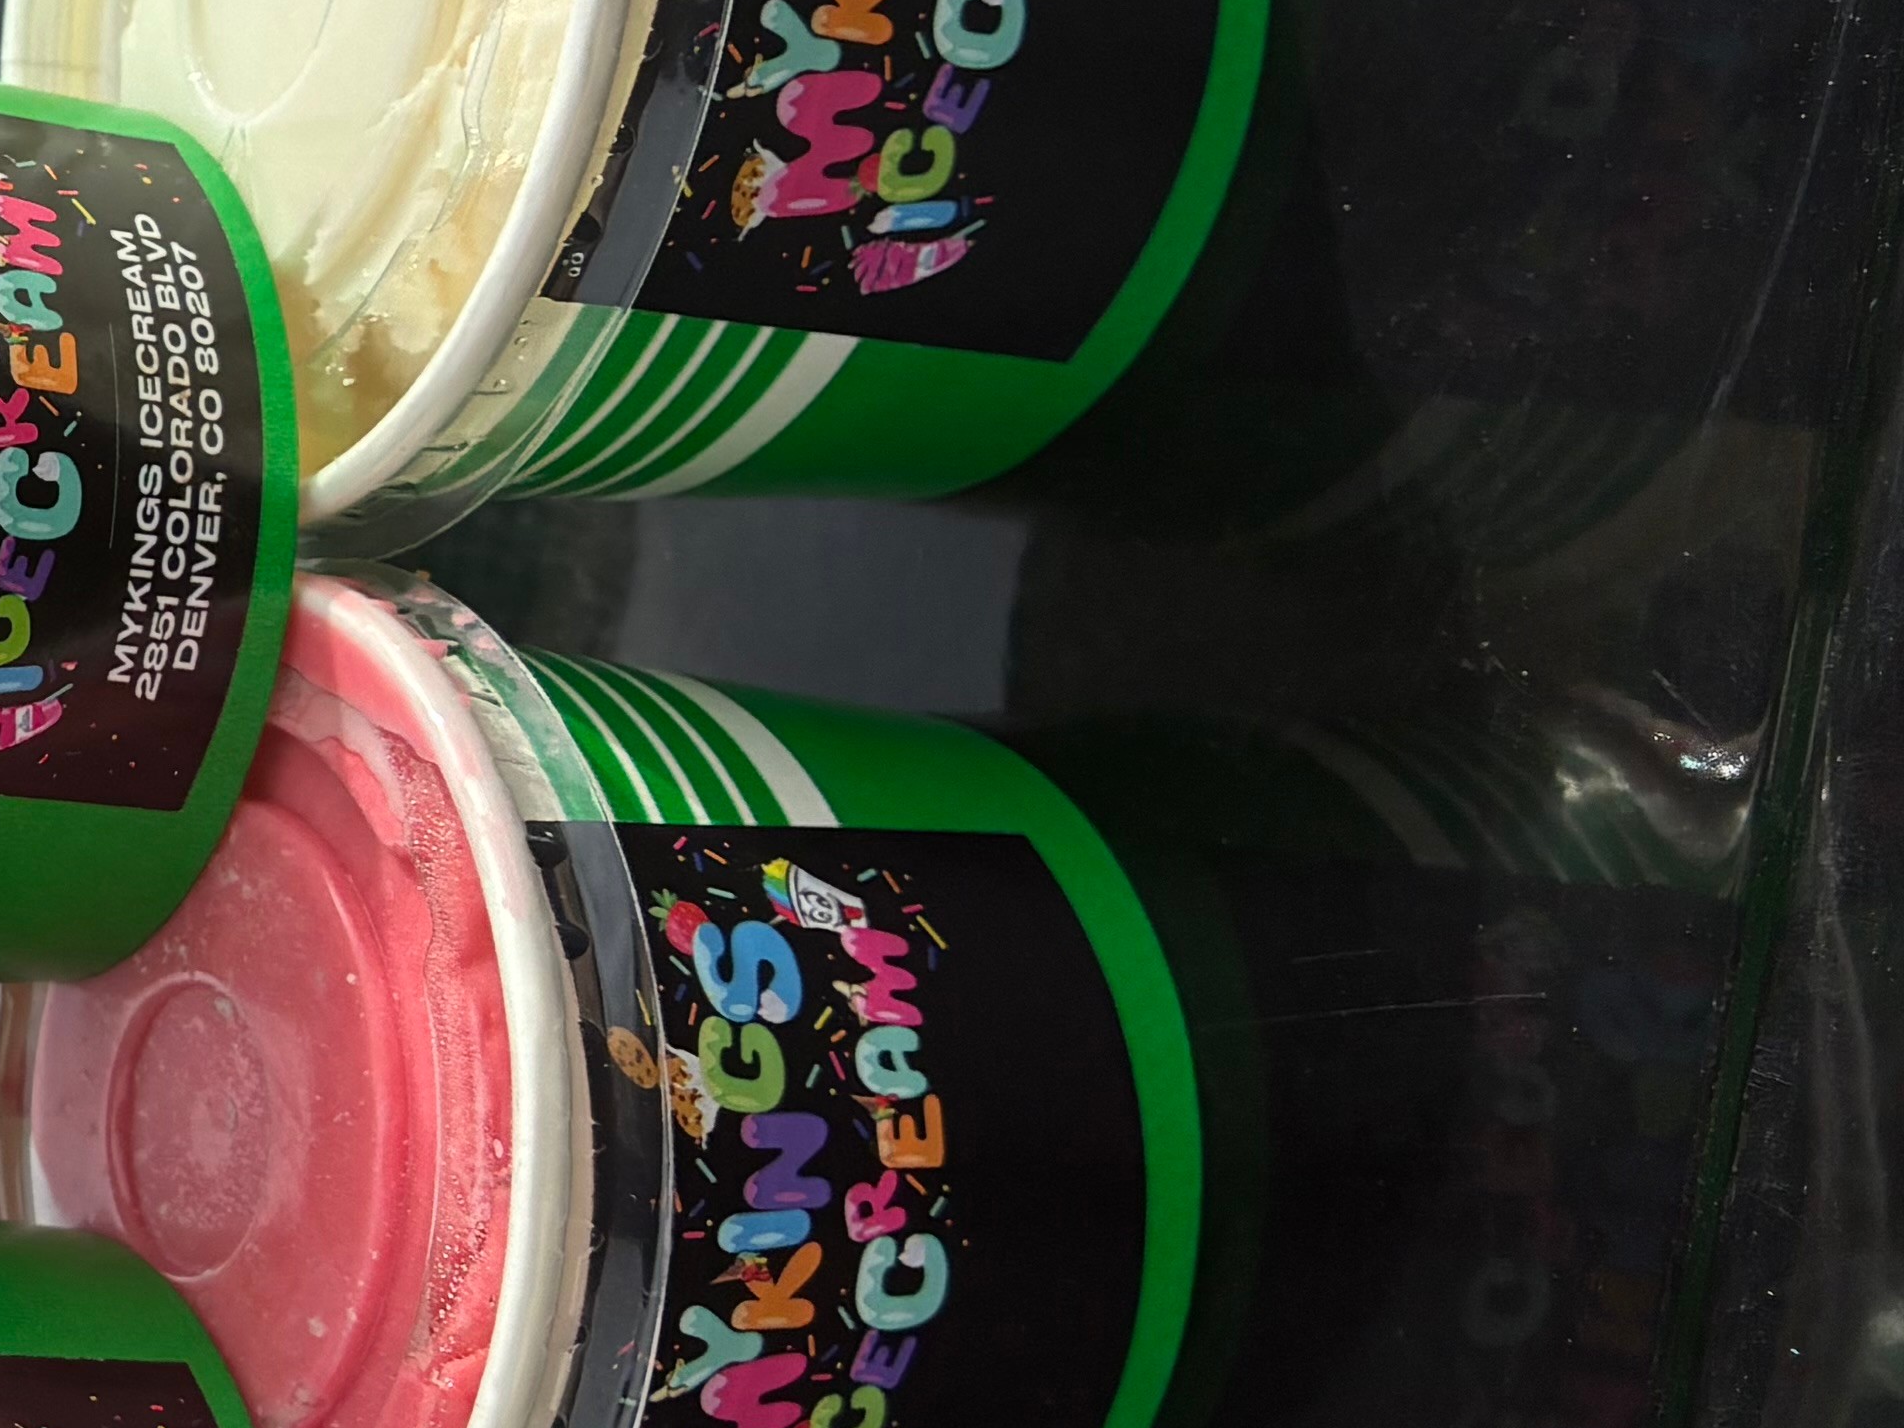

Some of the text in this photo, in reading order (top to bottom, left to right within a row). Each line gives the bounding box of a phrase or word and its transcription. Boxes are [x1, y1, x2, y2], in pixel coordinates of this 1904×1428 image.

[106, 229, 164, 684] MYKINGS ICECREAM
[134, 213, 194, 702] 2851 COLORADO BLVD
[170, 240, 228, 672] DENVER, CO 80207
